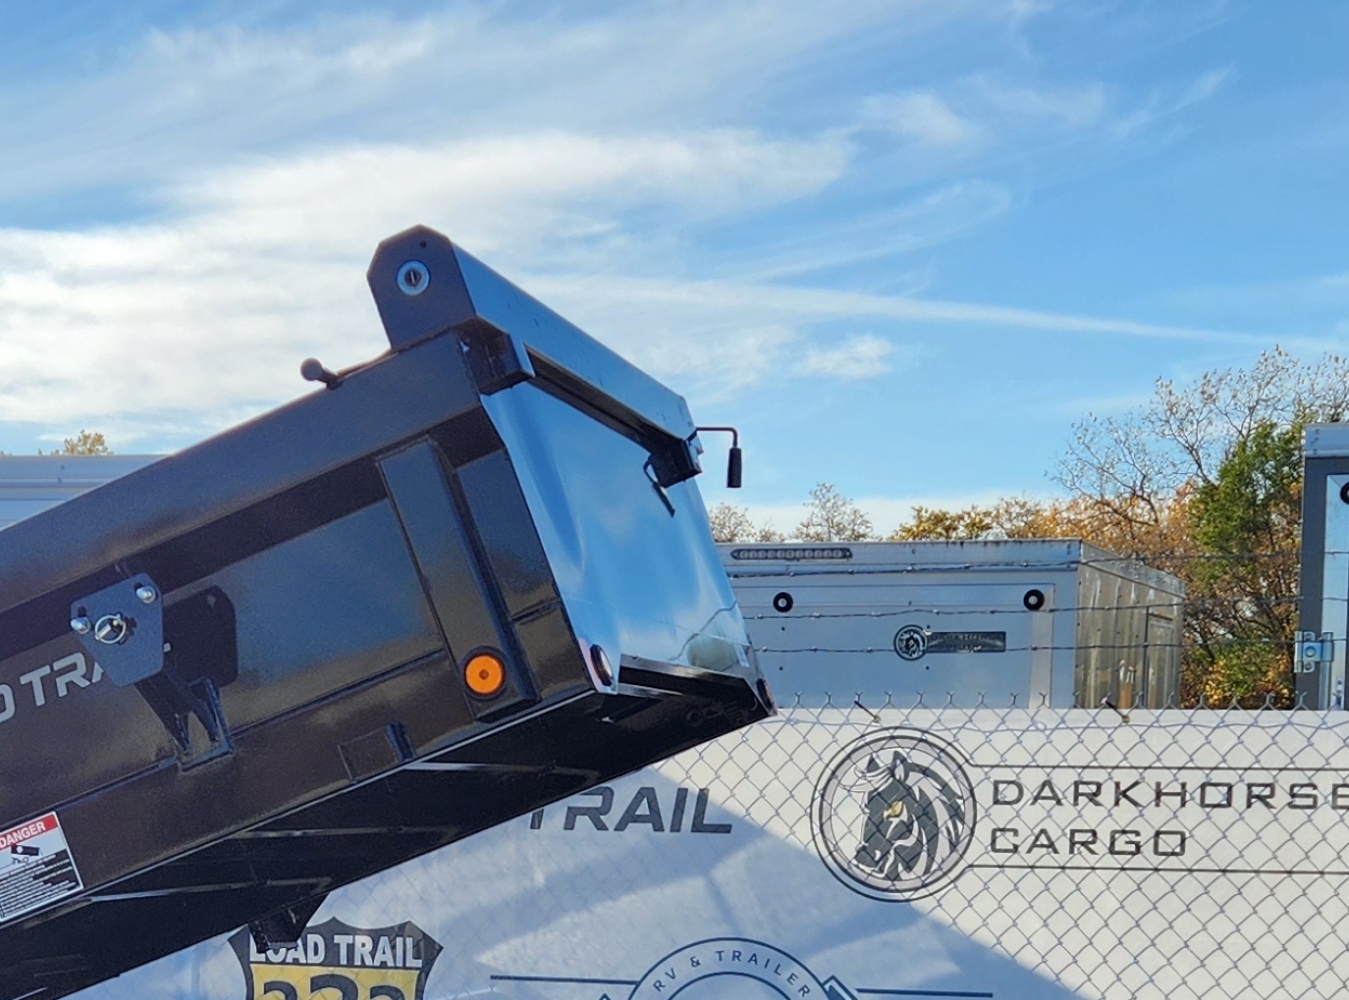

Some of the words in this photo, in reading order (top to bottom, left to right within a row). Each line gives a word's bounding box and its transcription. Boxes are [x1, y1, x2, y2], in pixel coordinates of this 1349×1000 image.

[990, 827, 1187, 857] CARGO
[334, 935, 423, 968] TRAIL
[653, 967, 679, 994] RV
[690, 955, 702, 969] &
[715, 949, 812, 999] TRAILER
